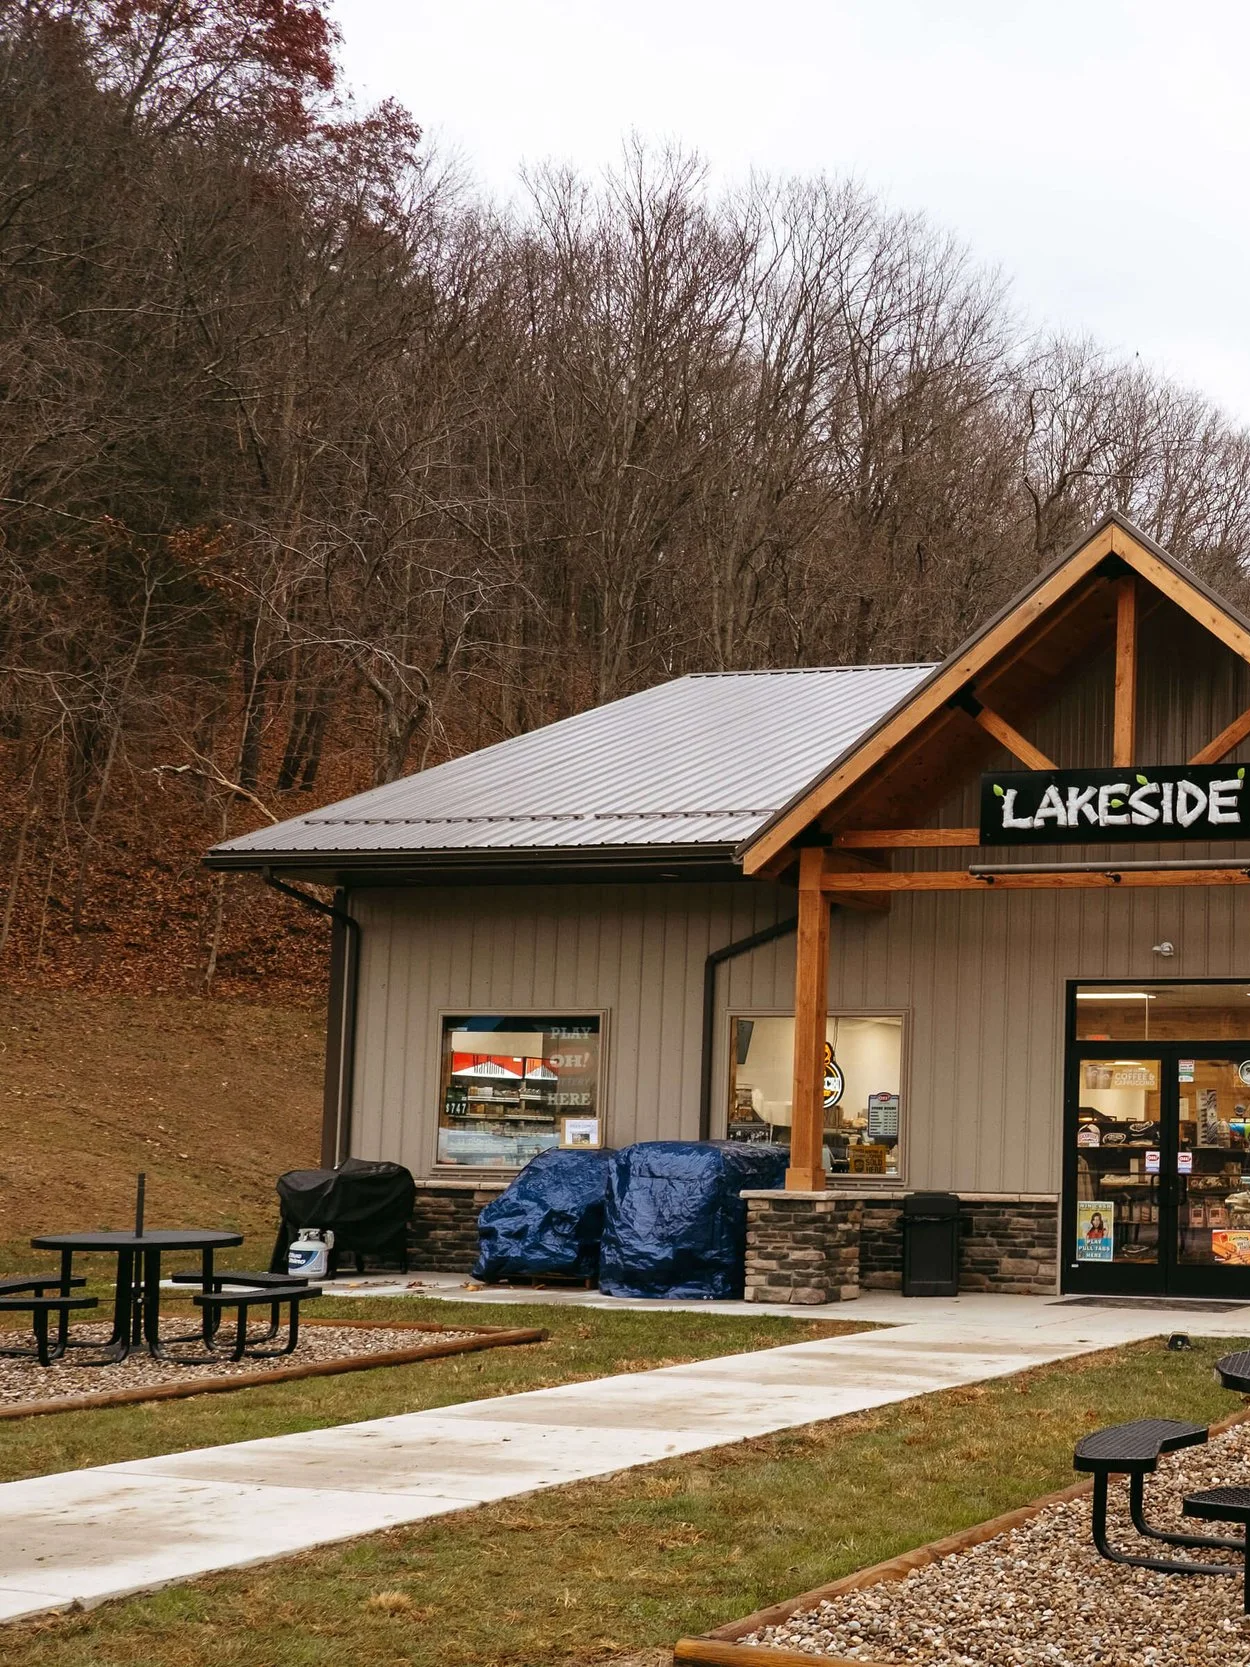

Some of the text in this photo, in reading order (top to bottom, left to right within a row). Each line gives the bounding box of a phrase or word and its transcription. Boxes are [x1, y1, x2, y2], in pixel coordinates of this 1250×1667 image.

[1001, 779, 1243, 829] LAKESIDE
[550, 1027, 592, 1040] PLAY
[549, 1052, 590, 1068] OH!
[1115, 1072, 1147, 1081] COFFEE
[548, 1093, 591, 1105] HERE
